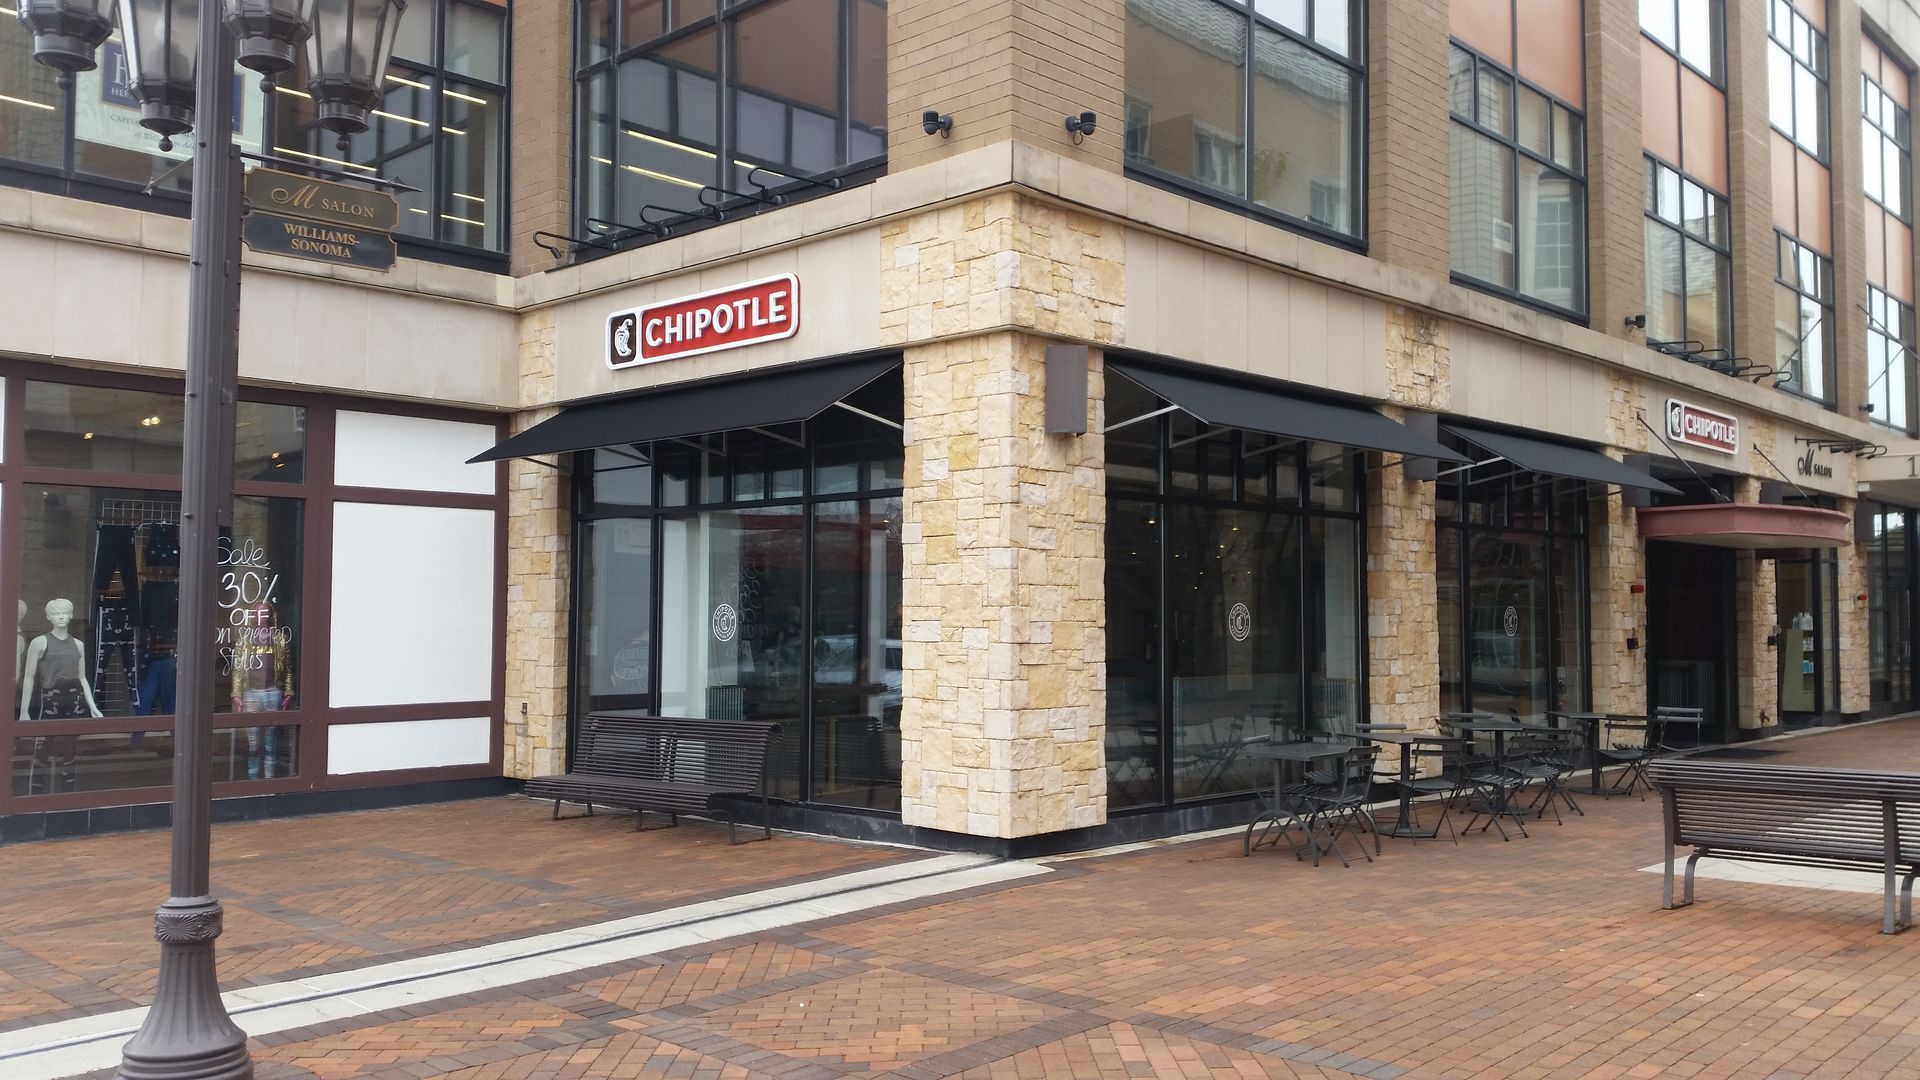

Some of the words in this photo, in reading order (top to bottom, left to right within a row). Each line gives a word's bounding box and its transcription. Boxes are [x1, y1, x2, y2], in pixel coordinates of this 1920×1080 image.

[271, 184, 320, 210] M
[321, 198, 375, 219] SALON
[283, 222, 360, 246] WILLIAMS-
[291, 238, 352, 259] SONOMA
[645, 289, 788, 348] CHIPOTLE
[1684, 413, 1737, 445] CHIPOTLE
[1813, 463, 1833, 479] SALON
[217, 536, 270, 567] Sale
[217, 571, 278, 609] 30%
[229, 607, 270, 626] OFF
